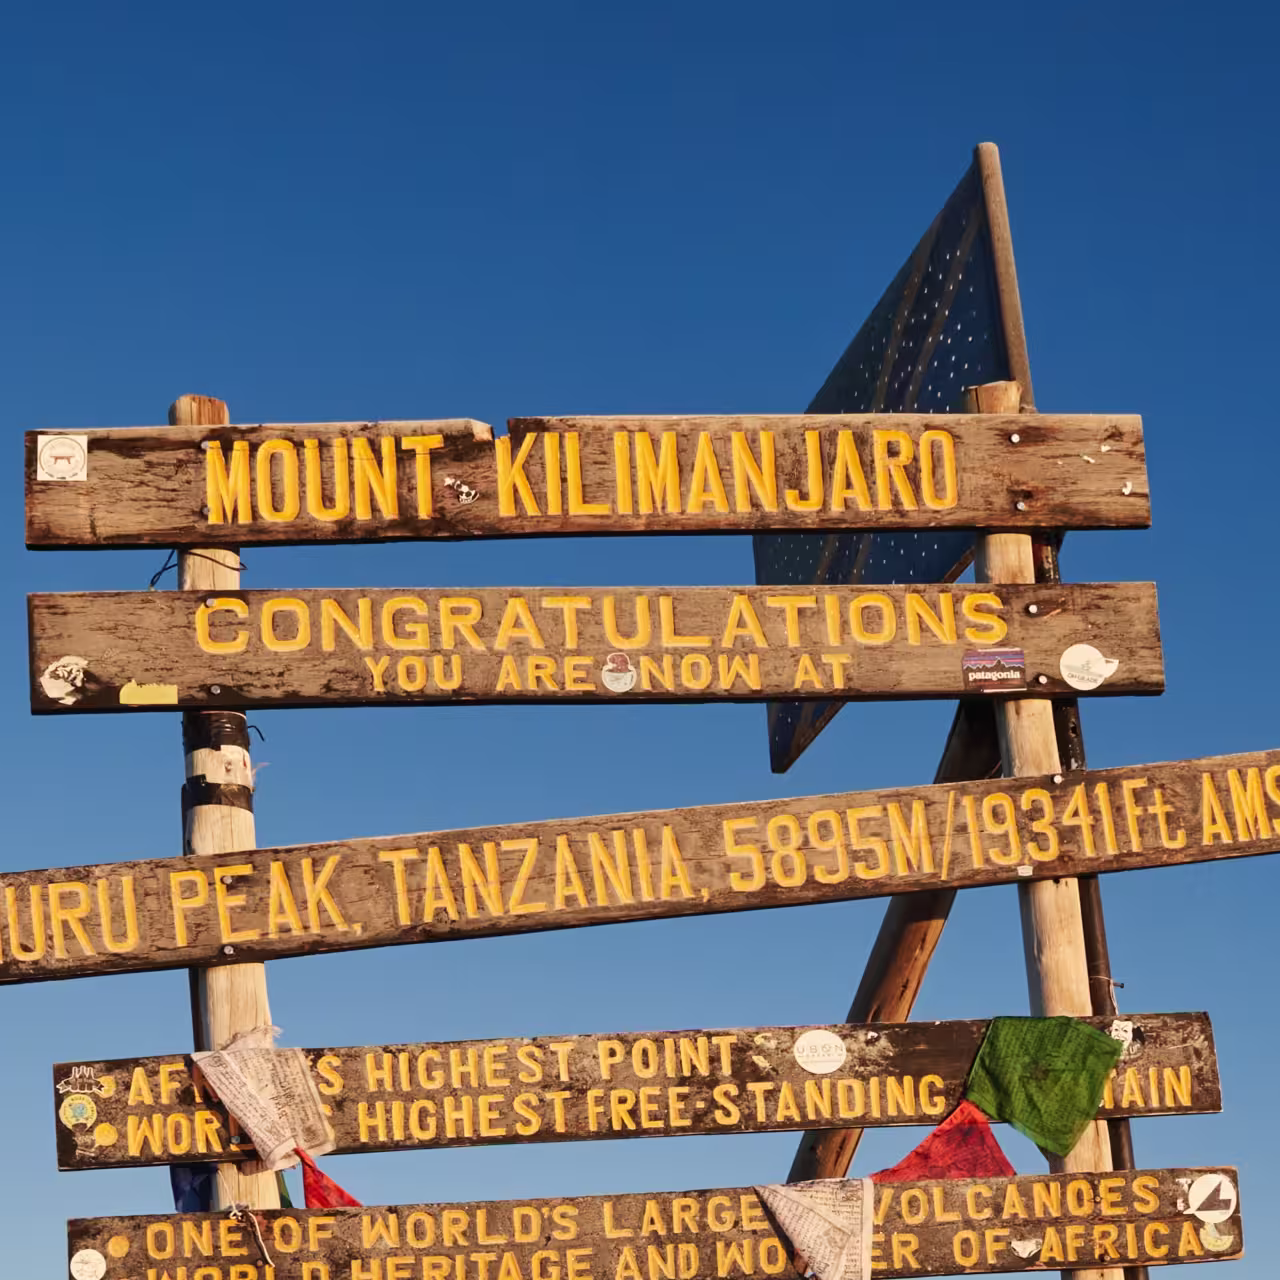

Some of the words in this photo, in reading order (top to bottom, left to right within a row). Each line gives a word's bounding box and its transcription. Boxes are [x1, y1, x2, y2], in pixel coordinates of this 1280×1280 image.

[205, 434, 444, 525] MOUNT
[495, 429, 959, 518] KILIMANJARO
[195, 592, 1009, 653] CONGRATULATIONS
[365, 654, 463, 692] YOU
[496, 654, 597, 692] ARE
[639, 653, 762, 691] NOW
[794, 652, 852, 690] AT
[968, 670, 1021, 681] patagonia
[168, 854, 364, 948] PEAK,
[377, 820, 711, 926] TANZANIA,
[365, 1041, 576, 1092] HIGHEST
[597, 1035, 737, 1080] POINT
[359, 1090, 571, 1143] HIGHEST
[146, 1218, 248, 1261] ONE
[273, 1216, 337, 1253] OF
[361, 1204, 579, 1249] WORLD'S
[872, 1175, 1160, 1226] VOLCANOES
[716, 1232, 922, 1278] WOER
[953, 1227, 1011, 1268] OF
[1039, 1220, 1205, 1264] AFRICA
